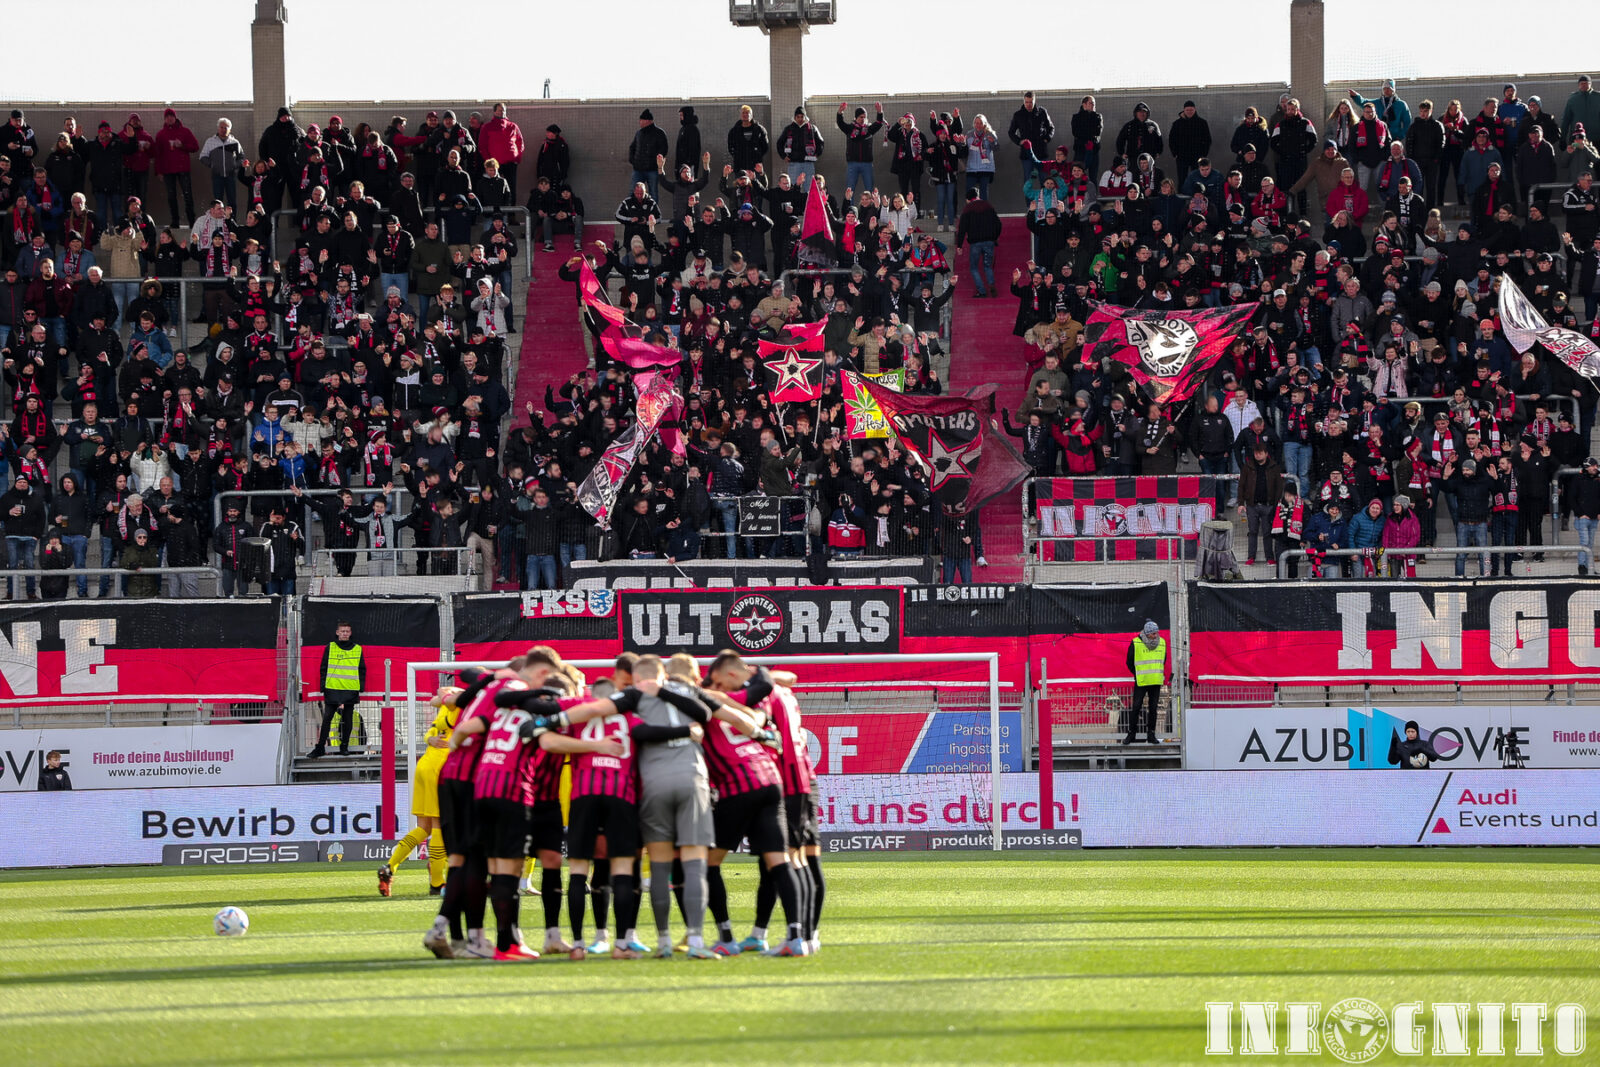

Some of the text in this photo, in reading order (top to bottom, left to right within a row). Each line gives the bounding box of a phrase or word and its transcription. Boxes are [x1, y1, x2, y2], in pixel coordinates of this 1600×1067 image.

[522, 589, 585, 617] FKS
[911, 588, 928, 602] IN
[732, 597, 777, 616] SUPPORTERS
[733, 630, 777, 649] INGOLSTADT
[485, 707, 532, 752] 29
[580, 713, 632, 759] 43
[953, 724, 1010, 738] Parsbg
[1553, 730, 1586, 743] Finde
[949, 743, 1010, 758] Ingolstdt
[1239, 727, 1365, 762] AZUBI
[93, 749, 234, 765] Finde deine Ausbildung!
[108, 764, 222, 777] www.azubimovie.de
[926, 762, 1011, 773] moebelhofde
[1458, 788, 1517, 805] Audi
[852, 803, 928, 825] uns
[1459, 811, 1598, 827] Events und
[142, 808, 296, 839] Bewirb
[829, 835, 906, 852] guSTAFF
[932, 833, 1079, 849] produkt.prosis.de
